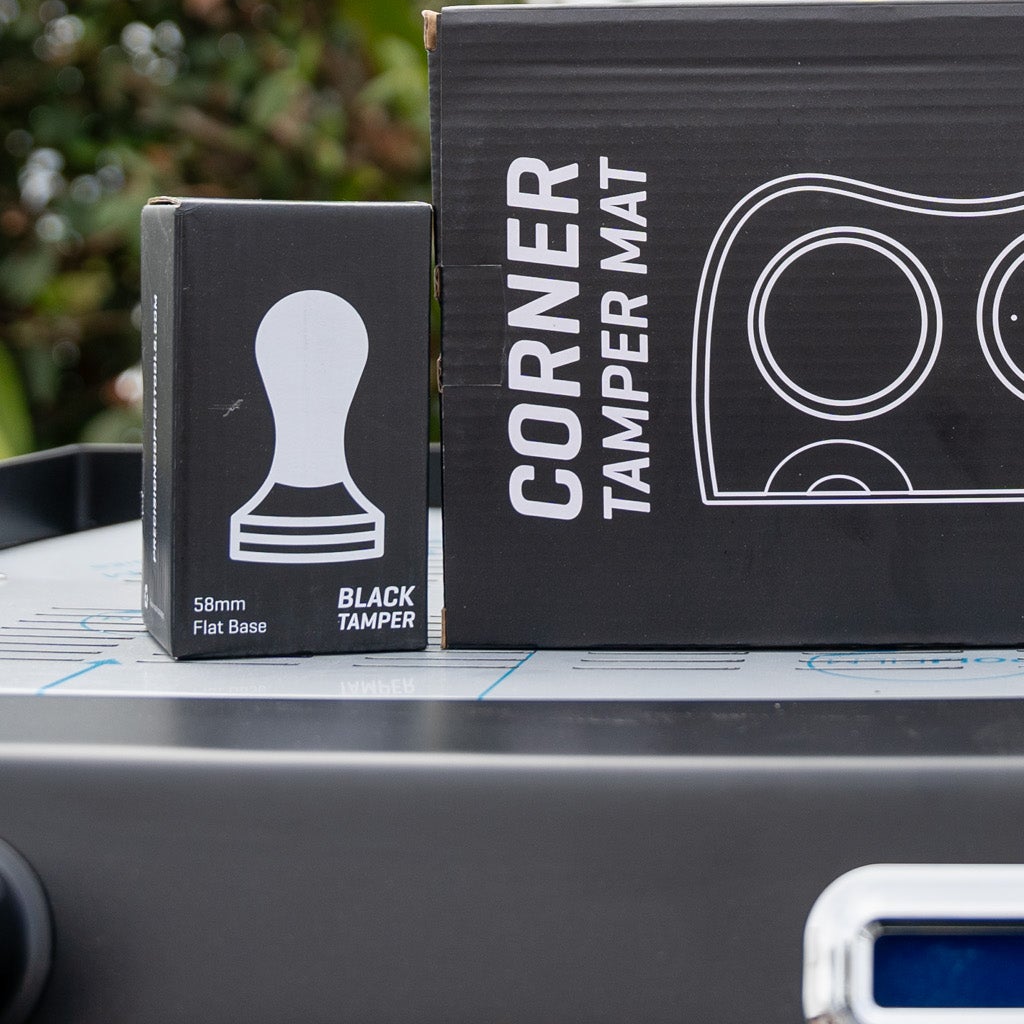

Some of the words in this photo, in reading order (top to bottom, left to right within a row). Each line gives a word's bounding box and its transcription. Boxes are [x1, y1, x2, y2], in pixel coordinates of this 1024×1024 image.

[599, 156, 647, 274] MAT
[506, 156, 583, 520] CORNER
[600, 290, 651, 519] TAMPER
[193, 597, 246, 613] 58mm
[338, 585, 416, 609] BLACK
[193, 620, 224, 635] Flat
[228, 619, 267, 635] Base
[338, 611, 416, 631] TAMPER
